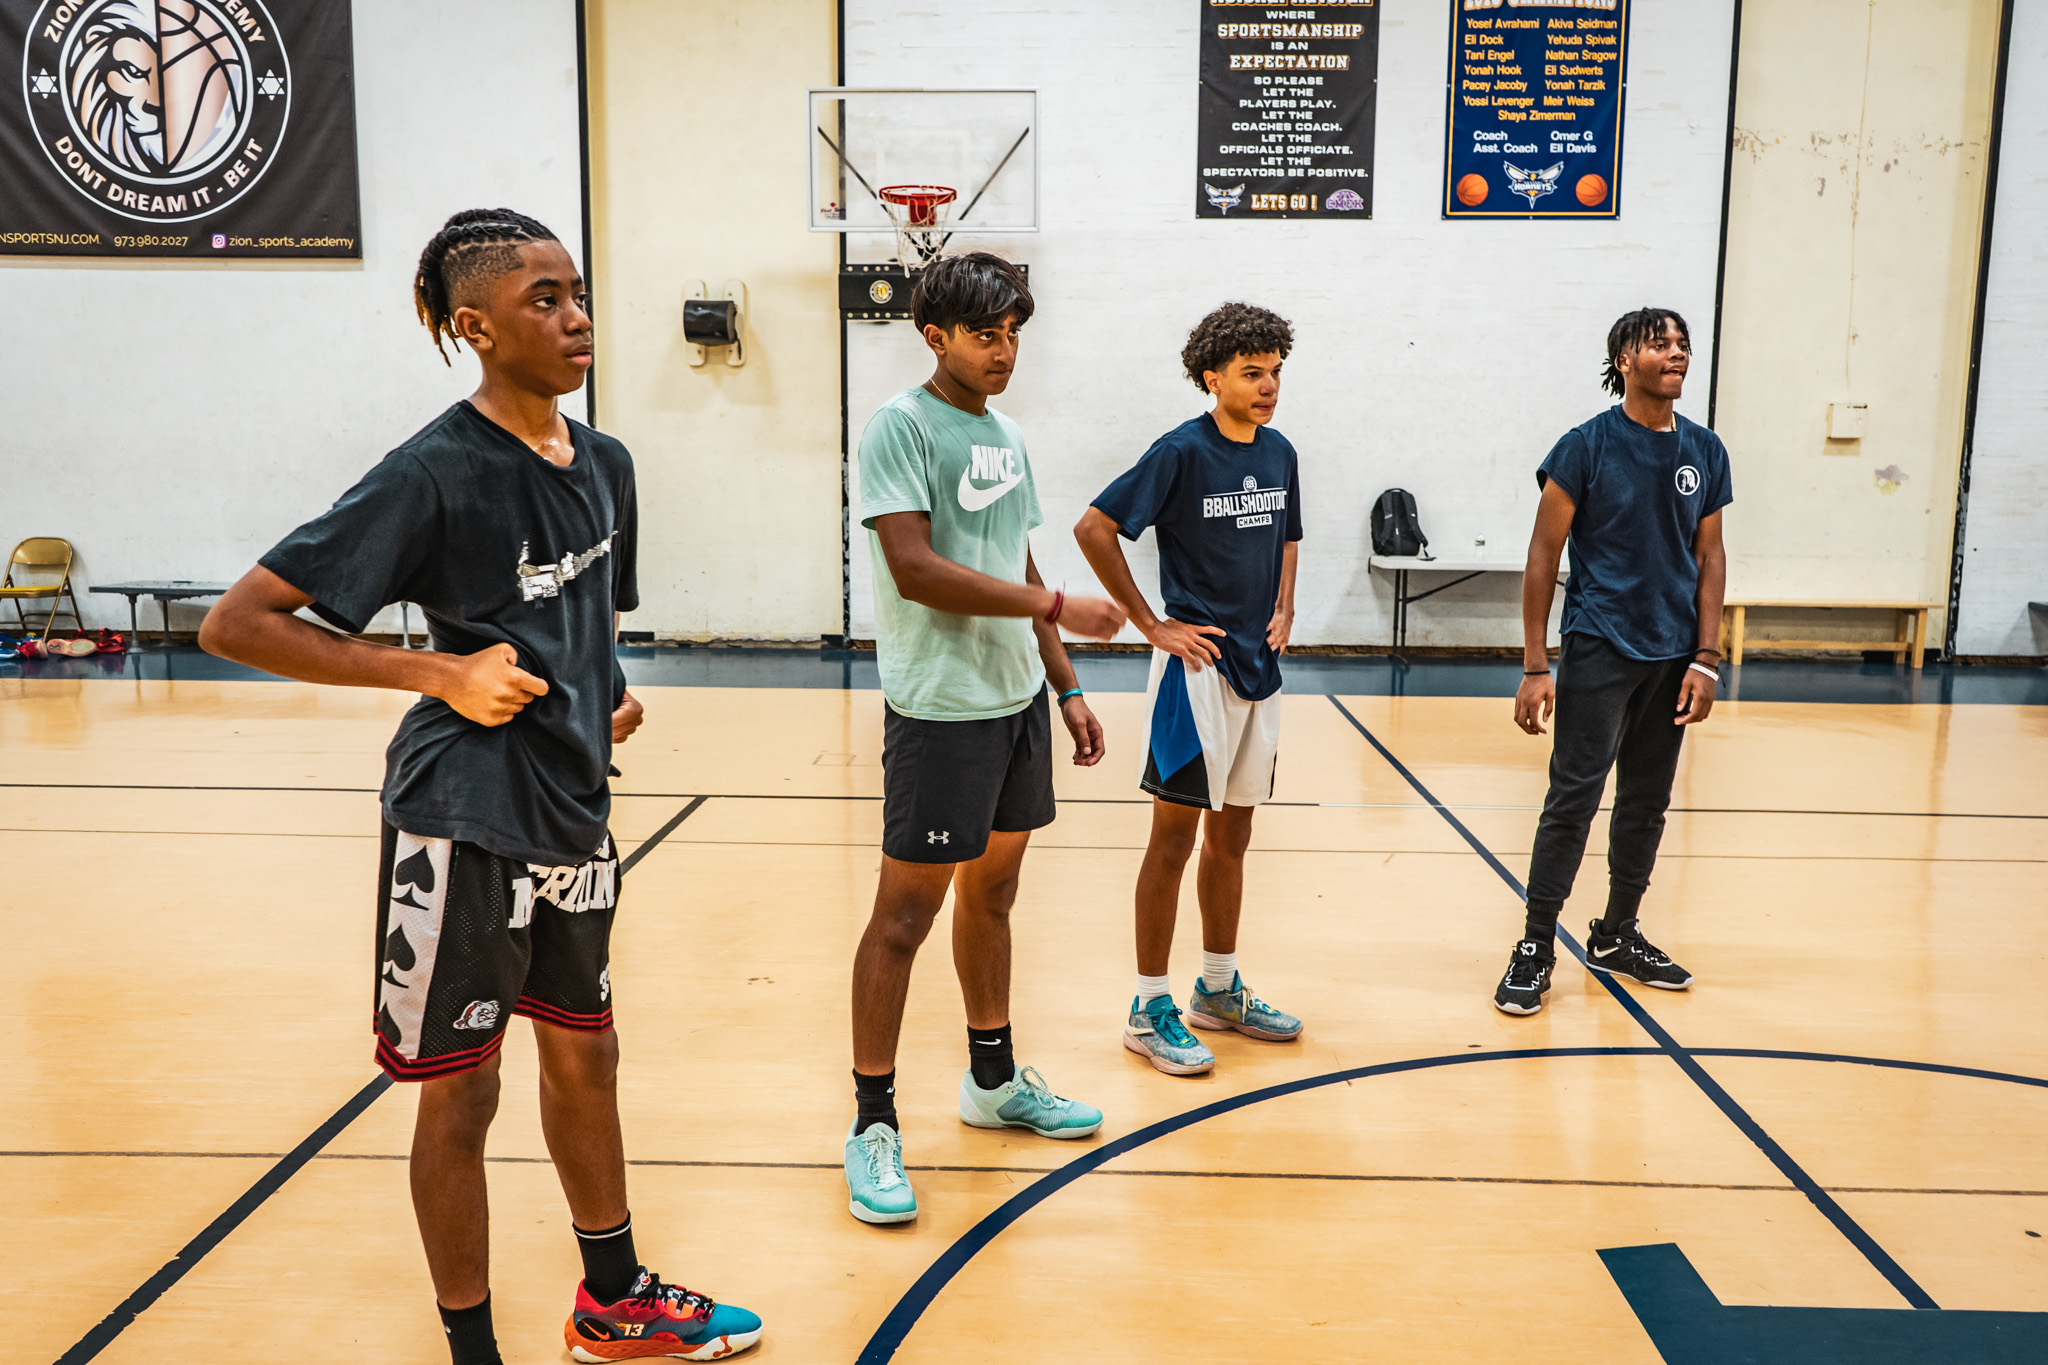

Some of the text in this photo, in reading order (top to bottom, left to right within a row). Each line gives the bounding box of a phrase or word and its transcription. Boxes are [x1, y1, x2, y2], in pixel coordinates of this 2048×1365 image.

[217, 0, 266, 42] EMY
[1266, 11, 1316, 20] WHERE
[1467, 18, 1540, 29] Yosef Avrahami
[1547, 18, 1617, 29] Akiva Seidman
[1218, 23, 1364, 39] SPORTSMANSHIP
[1464, 34, 1504, 45] Eli Dock
[1548, 34, 1617, 47] Yehuda Spivak
[1271, 42, 1308, 50] IS AN
[1465, 50, 1515, 62] Tani Engel
[1545, 50, 1617, 63] Nathan Sragow
[1229, 54, 1350, 70] EXPECTATION
[1464, 65, 1522, 75] Yonah Hook
[1545, 65, 1603, 75] Eli Sudwerts
[1254, 76, 1323, 85] SO PLEASE
[1463, 80, 1527, 92] Pacey Jacoby
[1545, 80, 1605, 90] Yonah Tarzik
[1263, 88, 1314, 97] LET THE
[1239, 100, 1336, 108] PLAYERS PLAY.
[1463, 95, 1535, 109] Yossi Levenger
[1544, 96, 1595, 106] Meir Weiss
[1262, 111, 1313, 120] LET THE
[1498, 110, 1576, 123] Shaya Zimerman
[1231, 122, 1343, 131] COACHES COACH.
[1261, 134, 1312, 143] LET THE
[1473, 130, 1508, 141] Coach
[1551, 131, 1593, 141] Omer G
[1219, 145, 1353, 154] OFFICIALS OFFICIATE.
[1473, 143, 1538, 153] Asst. Coach
[1550, 143, 1597, 153] Eli Davis
[1261, 157, 1311, 165] LET THE
[55, 136, 107, 188] DONT
[107, 183, 188, 213] DREAM
[192, 186, 211, 207] IT
[223, 159, 250, 188] BE
[244, 138, 263, 163] IT
[1203, 168, 1368, 177] SPECTATORS BE POSITIVE.
[1251, 194, 1288, 211] LETS
[1290, 194, 1309, 211] GO
[229, 236, 353, 249] zion_sports_academy
[971, 444, 1016, 482] NIKE
[1238, 515, 1270, 527] CHAMPS
[624, 1323, 644, 1336] 13
